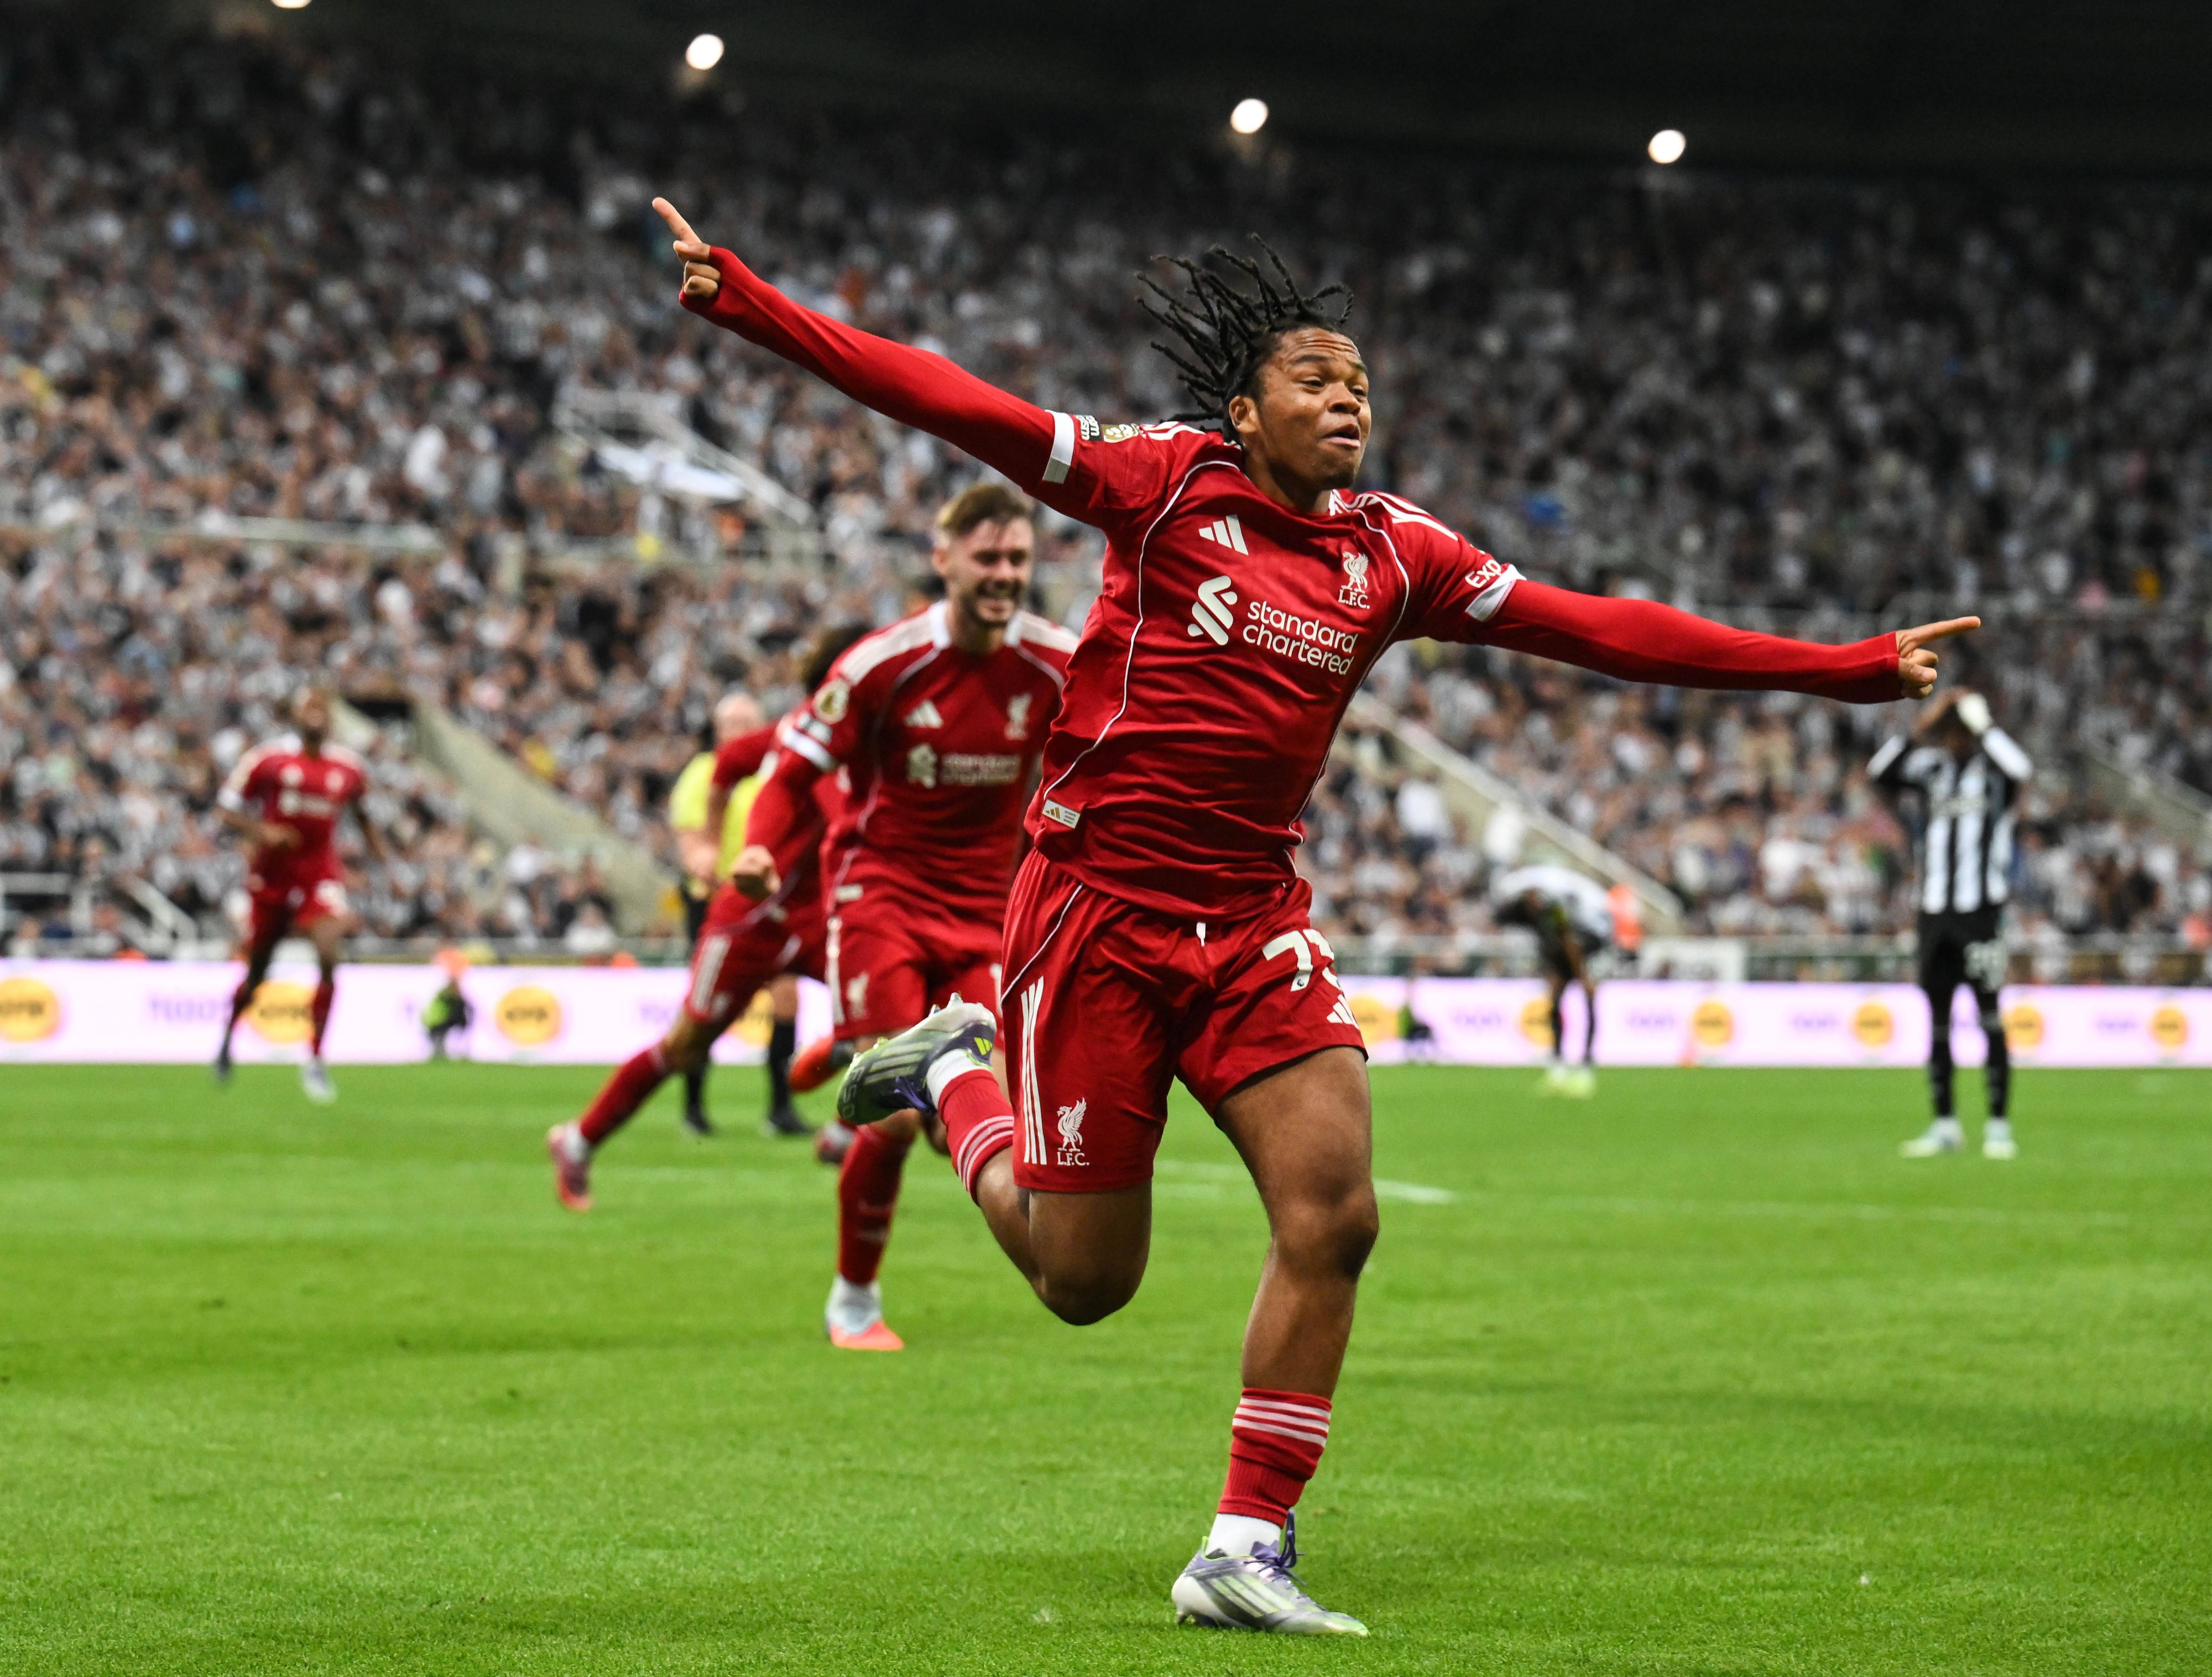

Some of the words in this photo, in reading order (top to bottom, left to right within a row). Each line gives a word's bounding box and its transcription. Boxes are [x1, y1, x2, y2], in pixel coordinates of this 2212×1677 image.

[1338, 589, 1370, 609] L.F.C.
[1247, 600, 1359, 654] standard
[1243, 623, 1354, 675] chartered
[1057, 1152, 1090, 1166] L.F.C.
